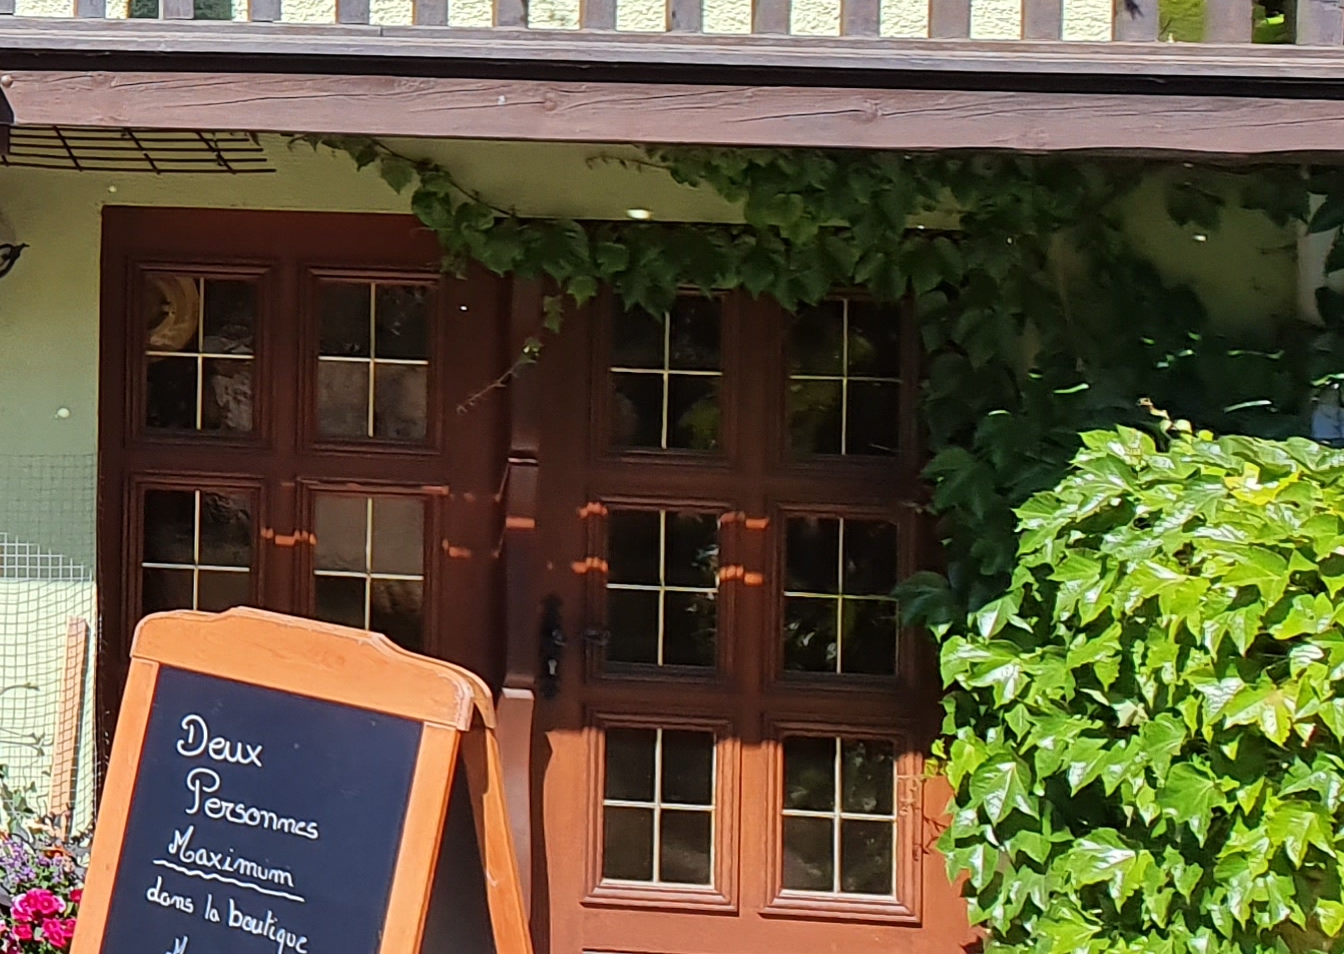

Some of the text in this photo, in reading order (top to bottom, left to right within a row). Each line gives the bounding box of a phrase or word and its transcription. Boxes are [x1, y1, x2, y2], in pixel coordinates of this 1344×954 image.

[176, 714, 263, 767] Deux
[185, 767, 320, 839] Personnes
[168, 825, 294, 887] Maximum
[146, 875, 194, 913] dans
[204, 894, 220, 922] la
[228, 898, 308, 954] boutique
